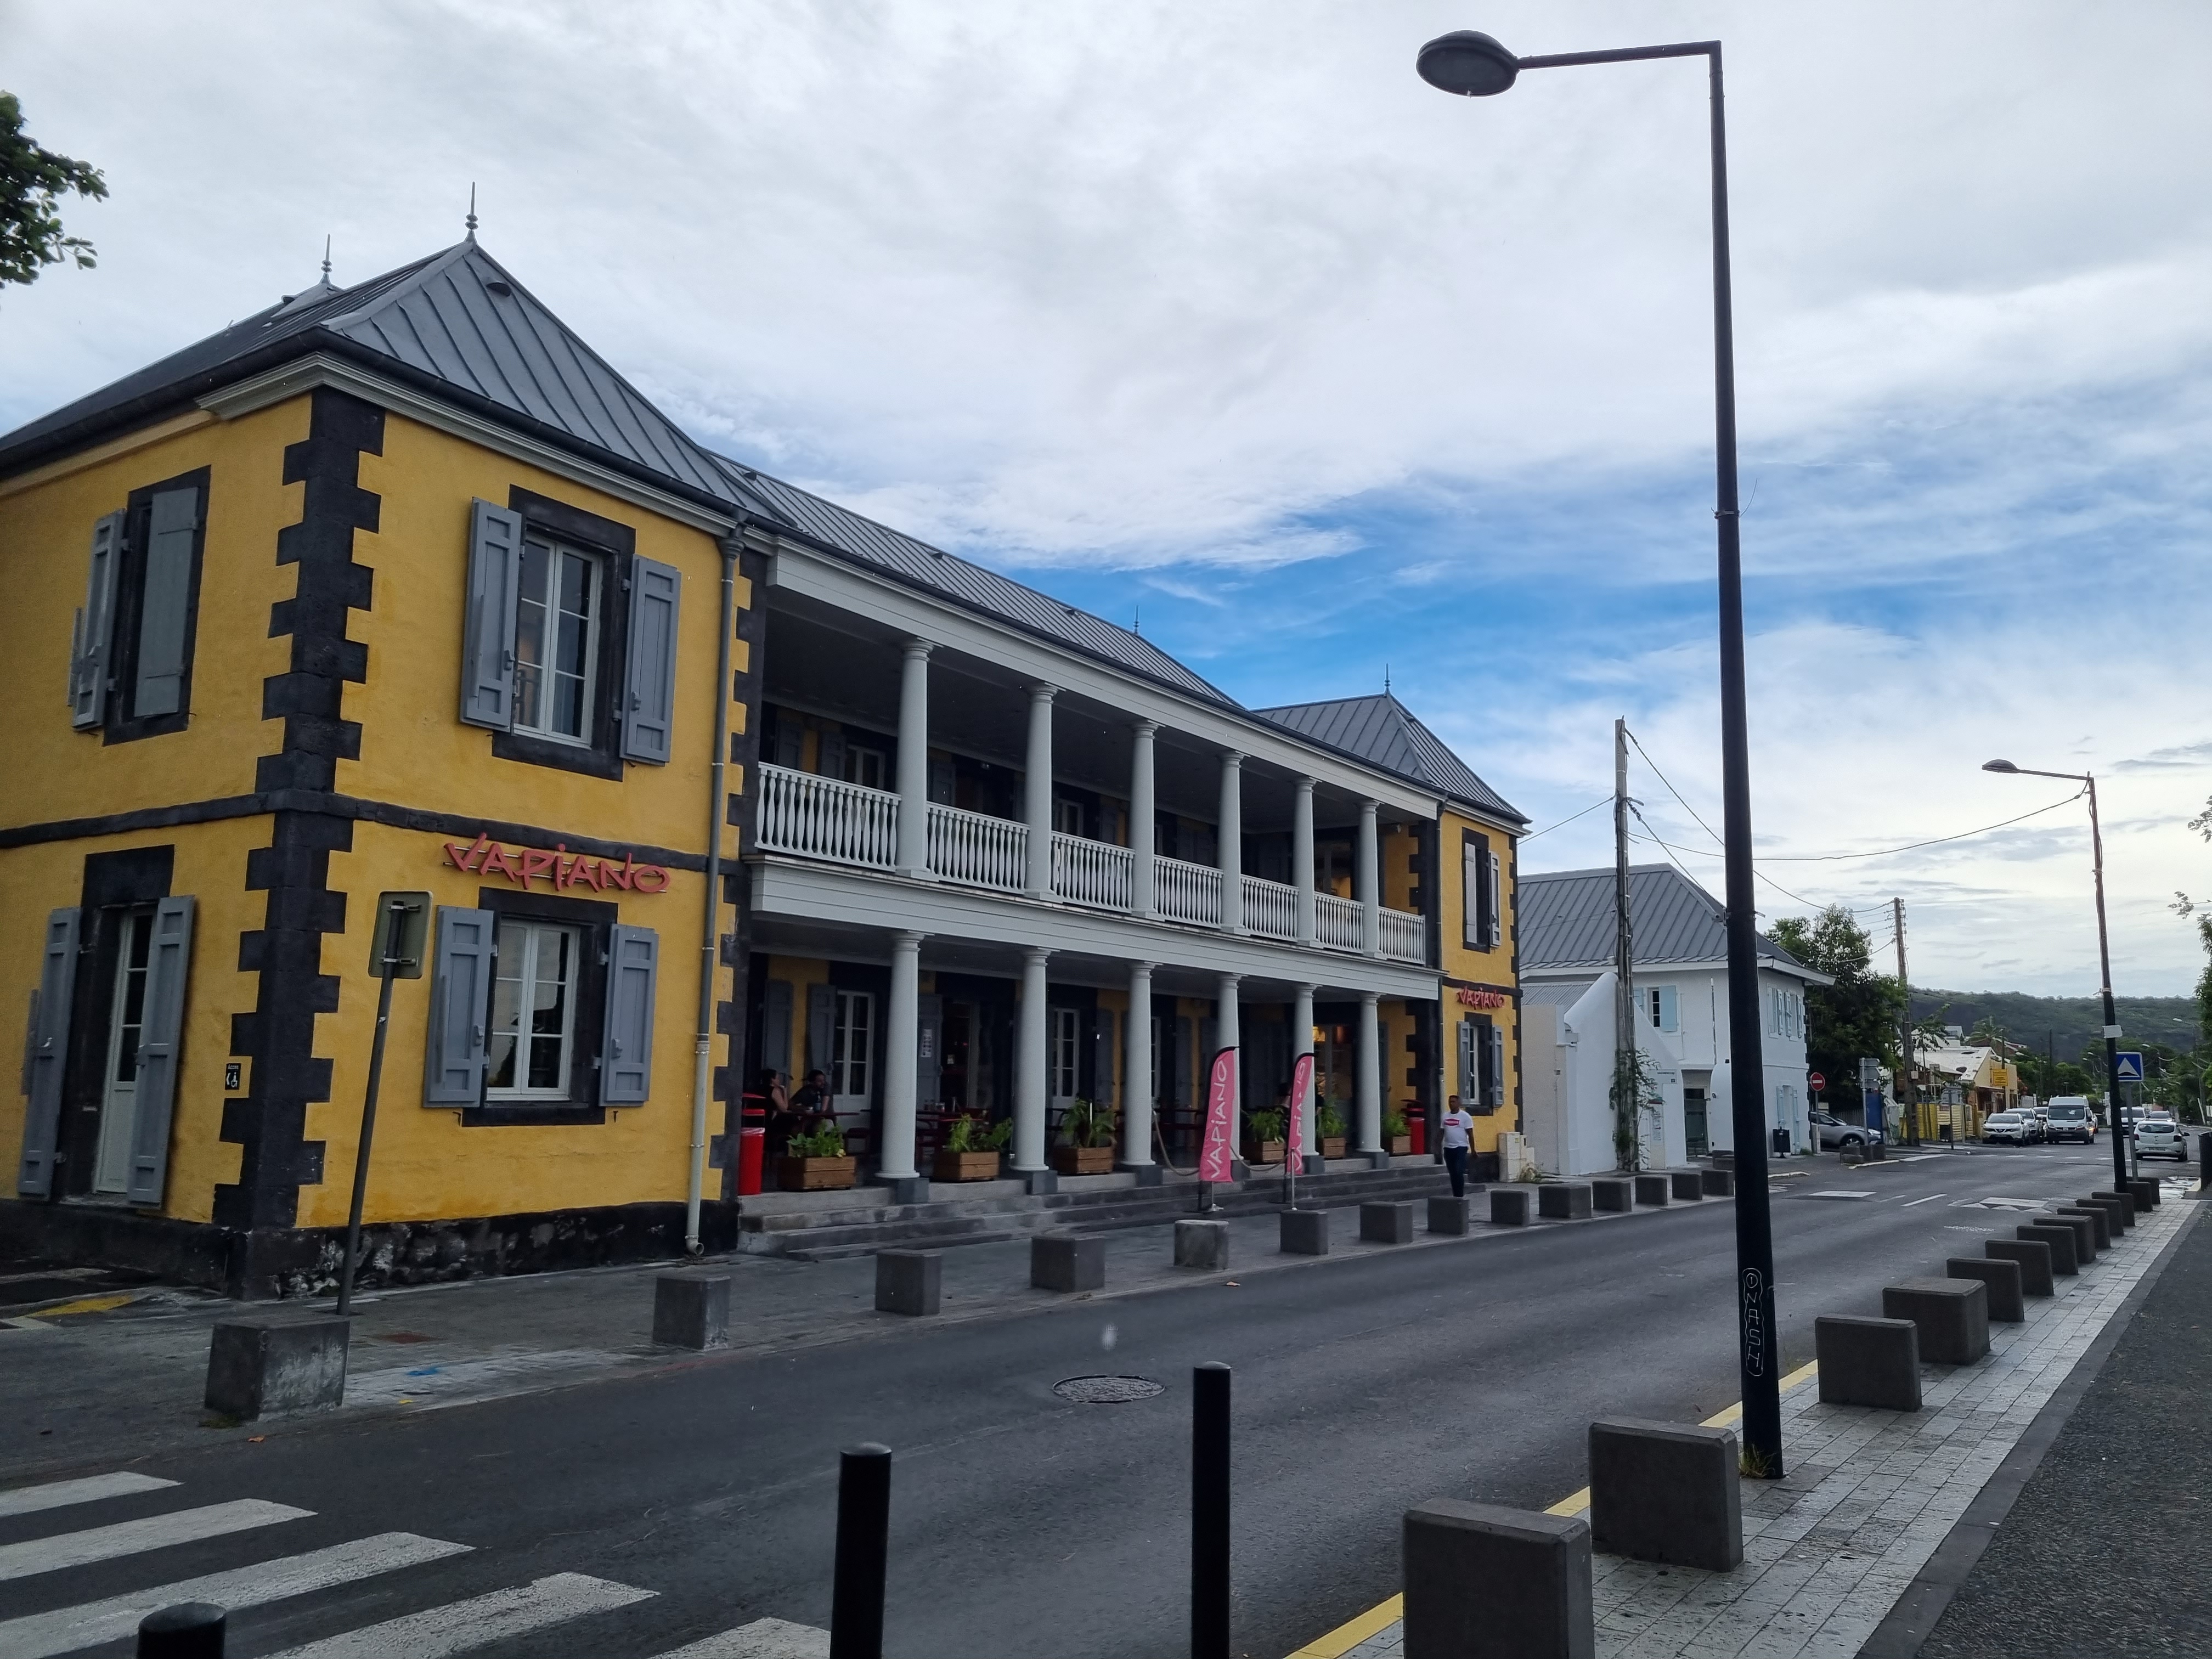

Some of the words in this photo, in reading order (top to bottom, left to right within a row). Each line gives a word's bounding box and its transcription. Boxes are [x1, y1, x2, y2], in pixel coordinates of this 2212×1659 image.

[444, 832, 670, 893] VAPIANO
[1457, 985, 1505, 1010] VAPIANO
[1206, 1060, 1227, 1178] VAPIANO
